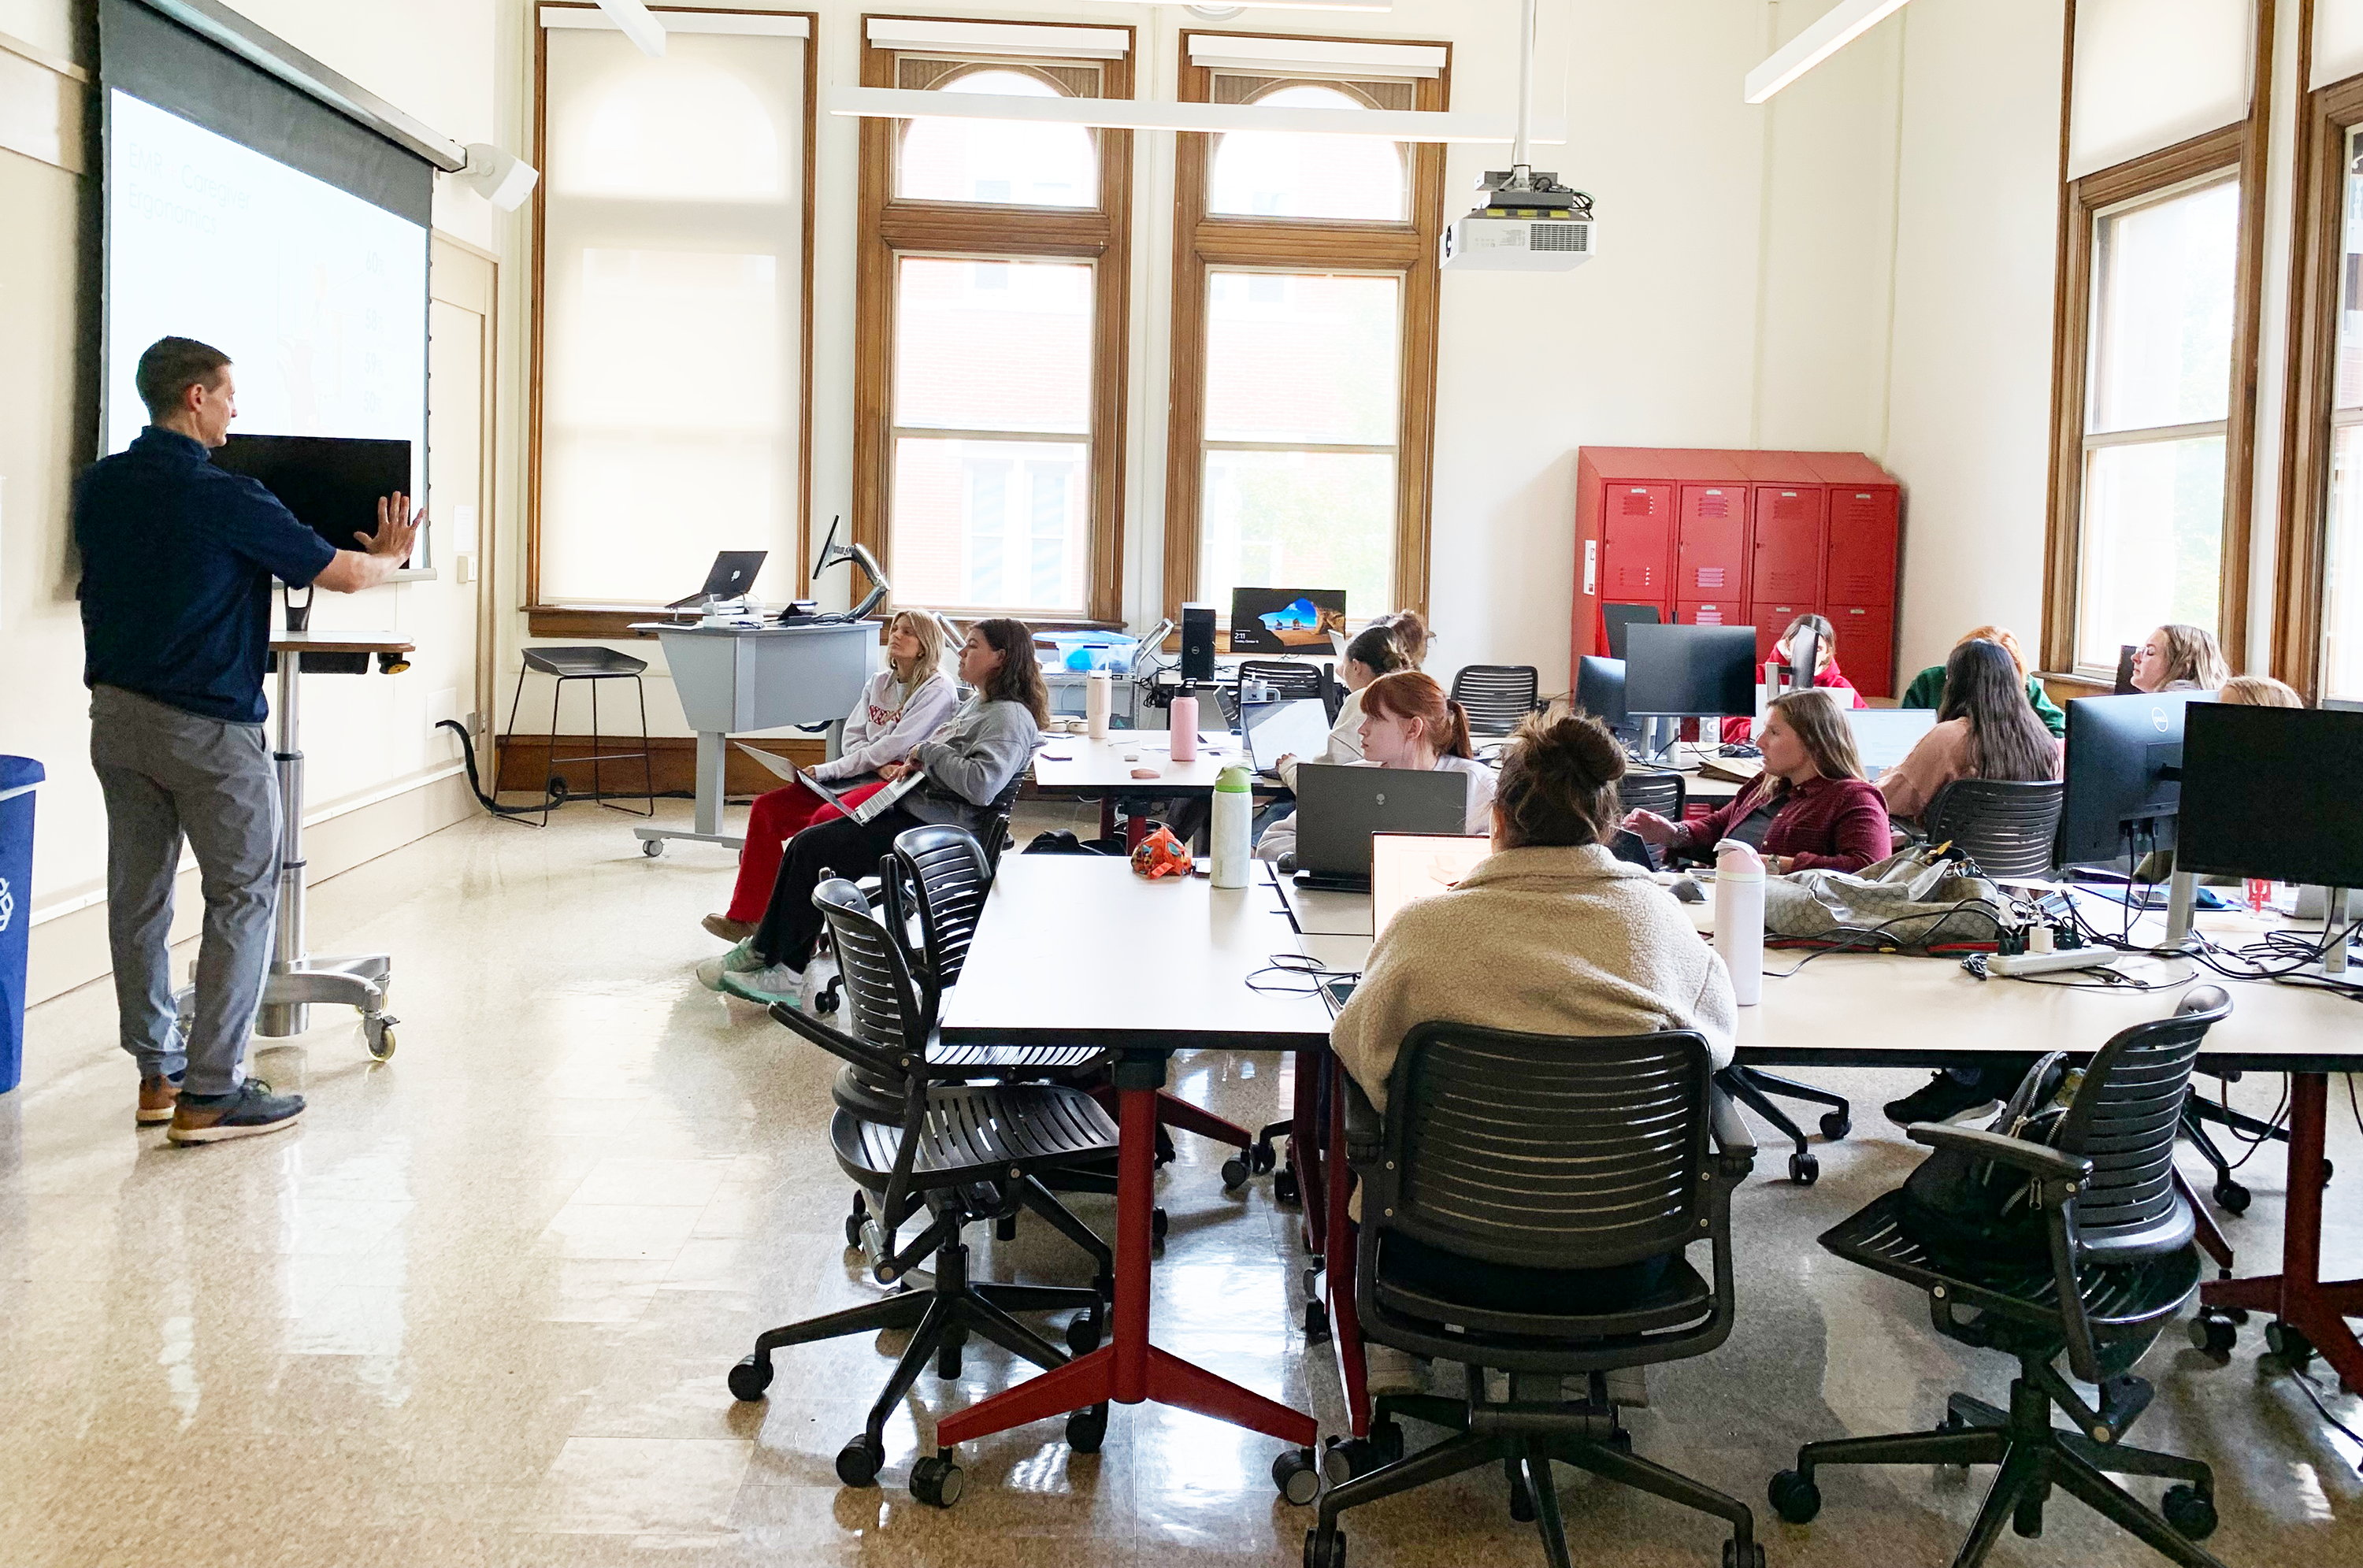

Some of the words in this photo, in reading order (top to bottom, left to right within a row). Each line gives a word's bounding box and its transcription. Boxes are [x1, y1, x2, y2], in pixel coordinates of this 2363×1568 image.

[129, 142, 163, 179] EMR
[181, 164, 251, 211] Caregiver
[128, 182, 217, 235] Ergonomics
[365, 250, 385, 276] 60%
[365, 307, 384, 334] 58%
[364, 351, 384, 377] 59%
[362, 390, 383, 415] 50%
